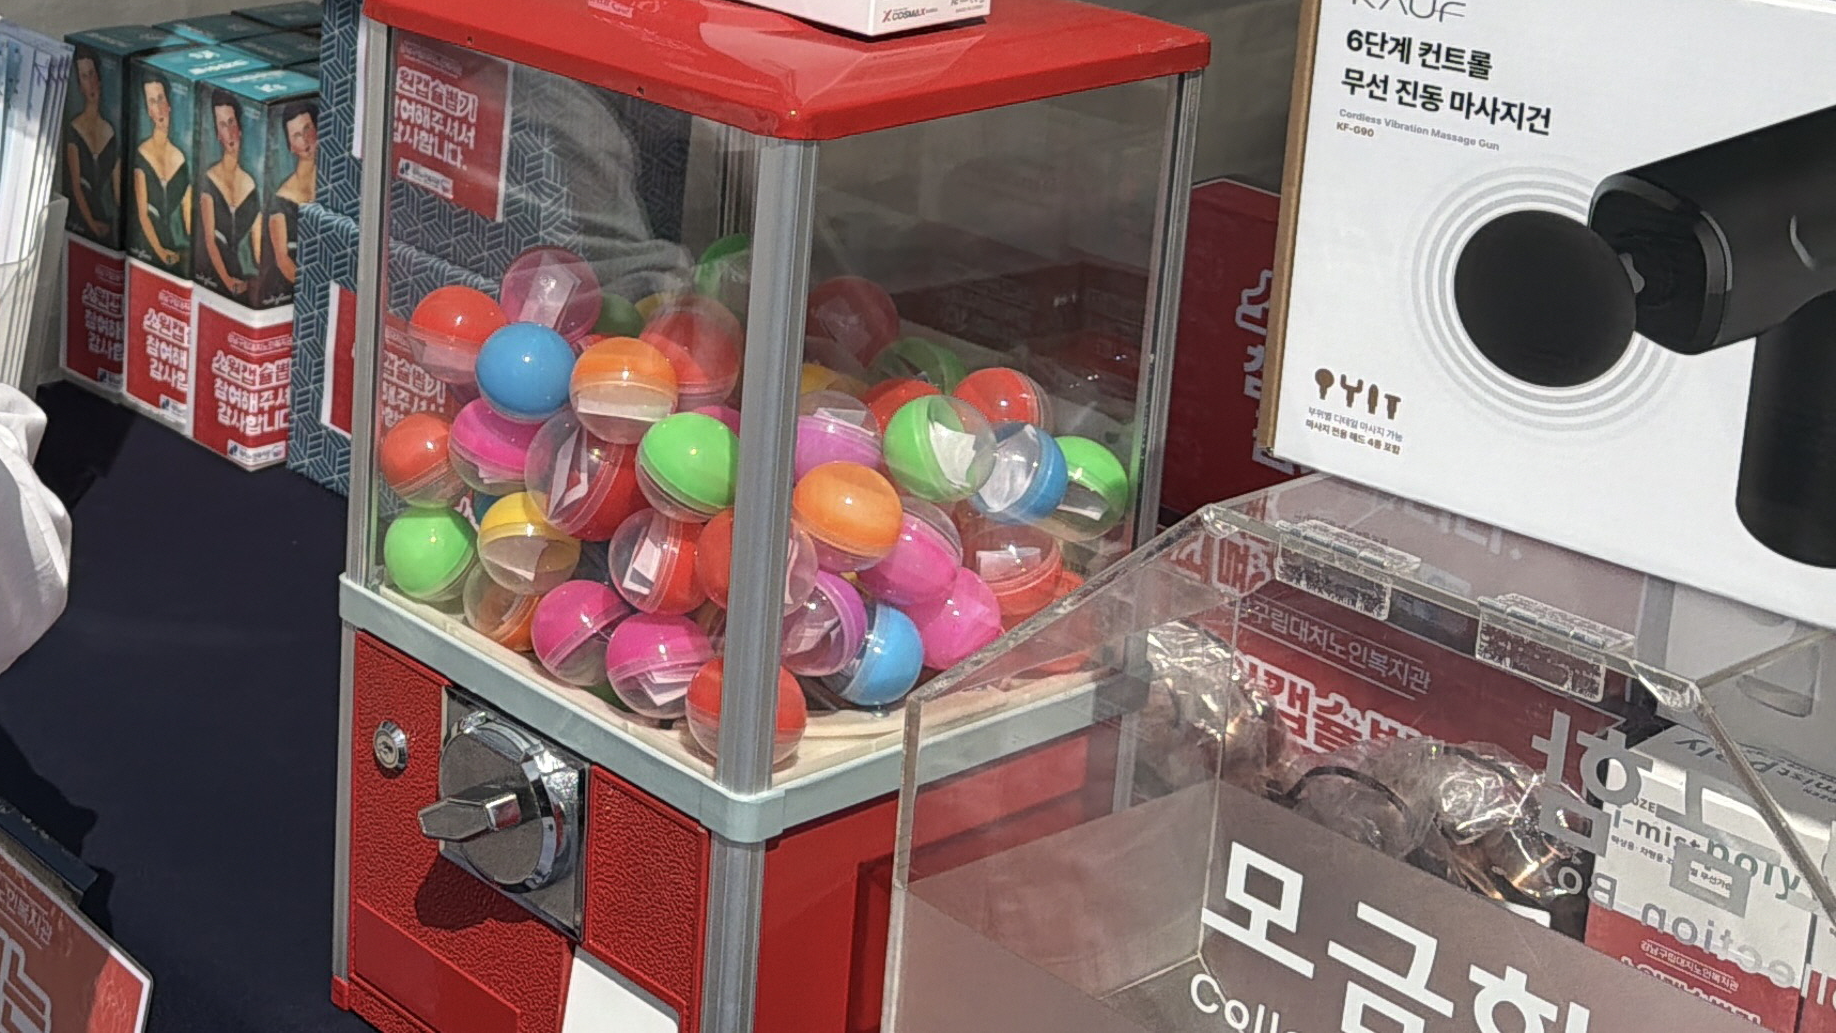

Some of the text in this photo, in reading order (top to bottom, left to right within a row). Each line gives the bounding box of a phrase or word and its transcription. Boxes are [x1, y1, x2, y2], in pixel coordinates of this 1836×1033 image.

[1347, 29, 1492, 80] 6단계 컨트롤
[1341, 68, 1551, 136] 무선 진동 마사지건
[1339, 109, 1500, 151] Cordless Vibration Massage Gun
[1306, 419, 1330, 434] 마사지
[1332, 428, 1347, 439] 전용
[1349, 432, 1366, 444] 헤드
[1383, 442, 1400, 455] 포함
[1309, 407, 1403, 442] 부위별 디테일 마사지 가능
